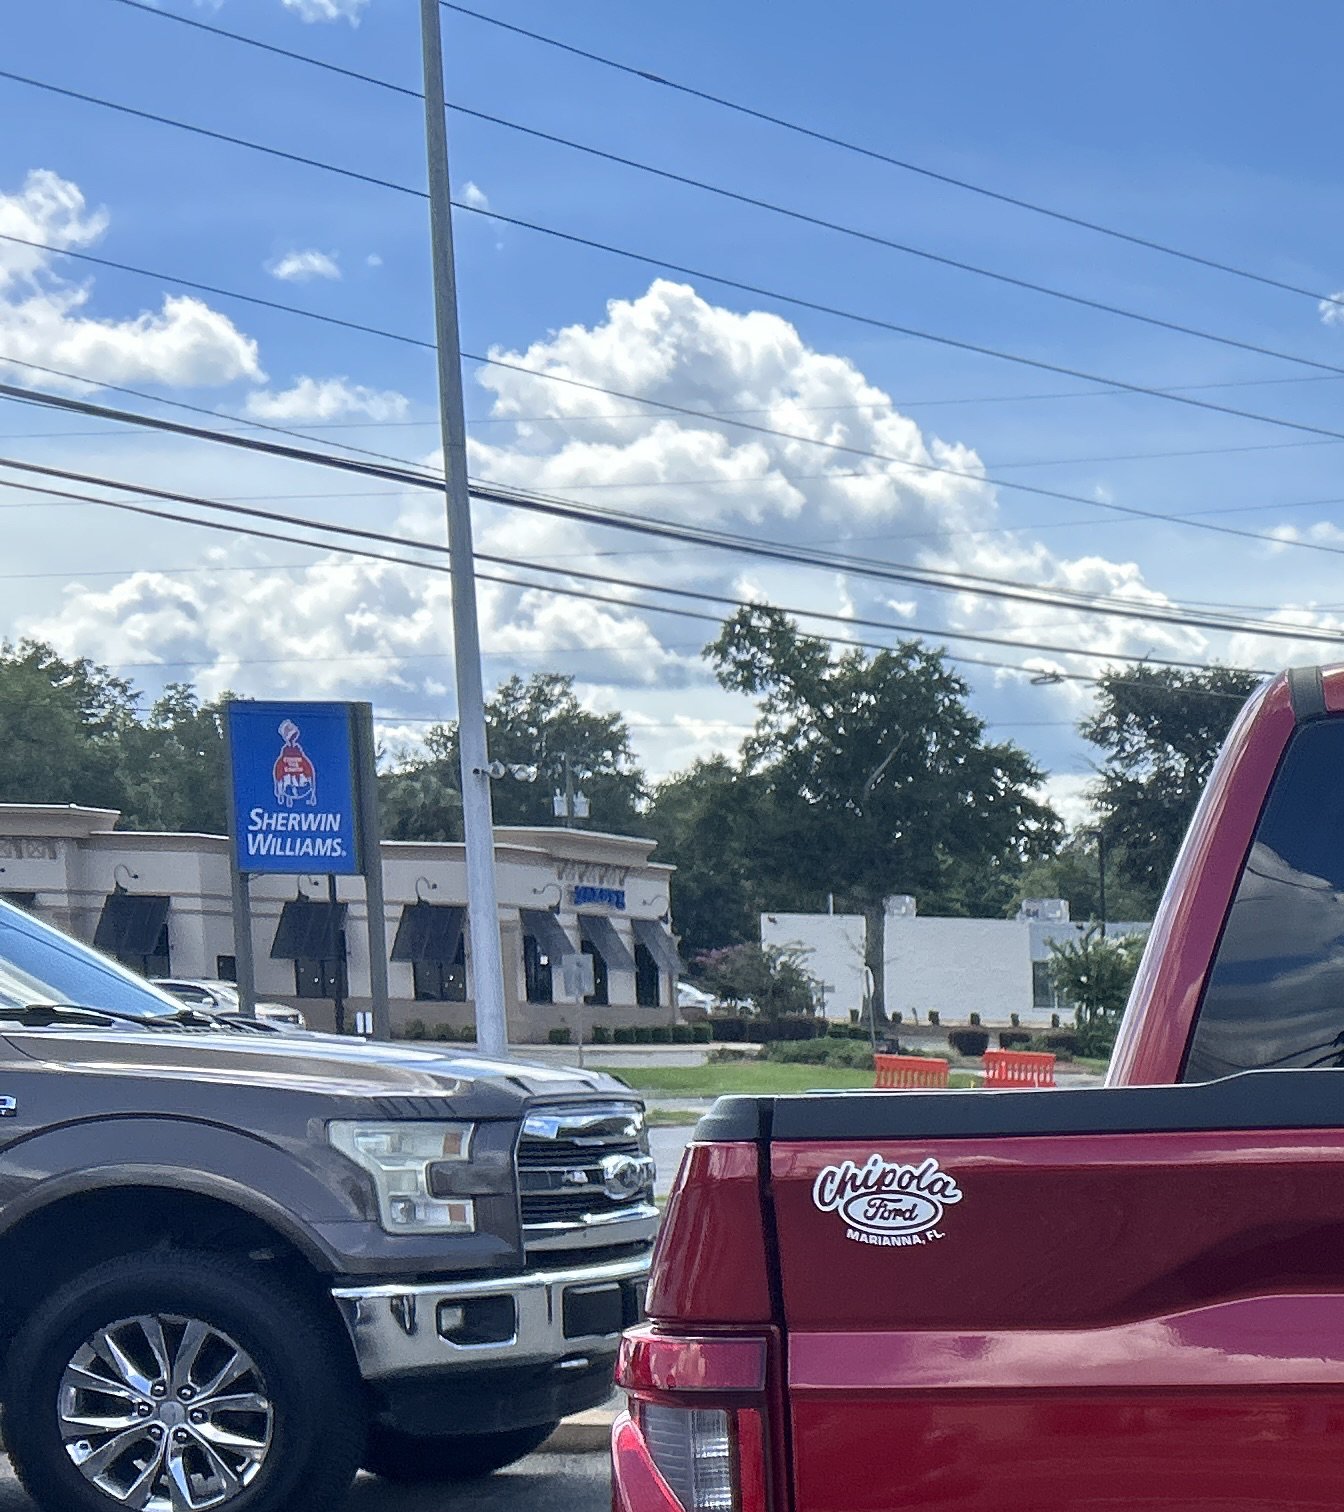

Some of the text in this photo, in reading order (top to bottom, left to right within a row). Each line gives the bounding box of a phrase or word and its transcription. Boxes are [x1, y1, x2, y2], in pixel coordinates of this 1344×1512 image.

[247, 807, 341, 832] SHERWIN
[816, 1156, 960, 1208] Chipola
[863, 1196, 920, 1222] Ford
[846, 1228, 926, 1247] MARIANNA,
